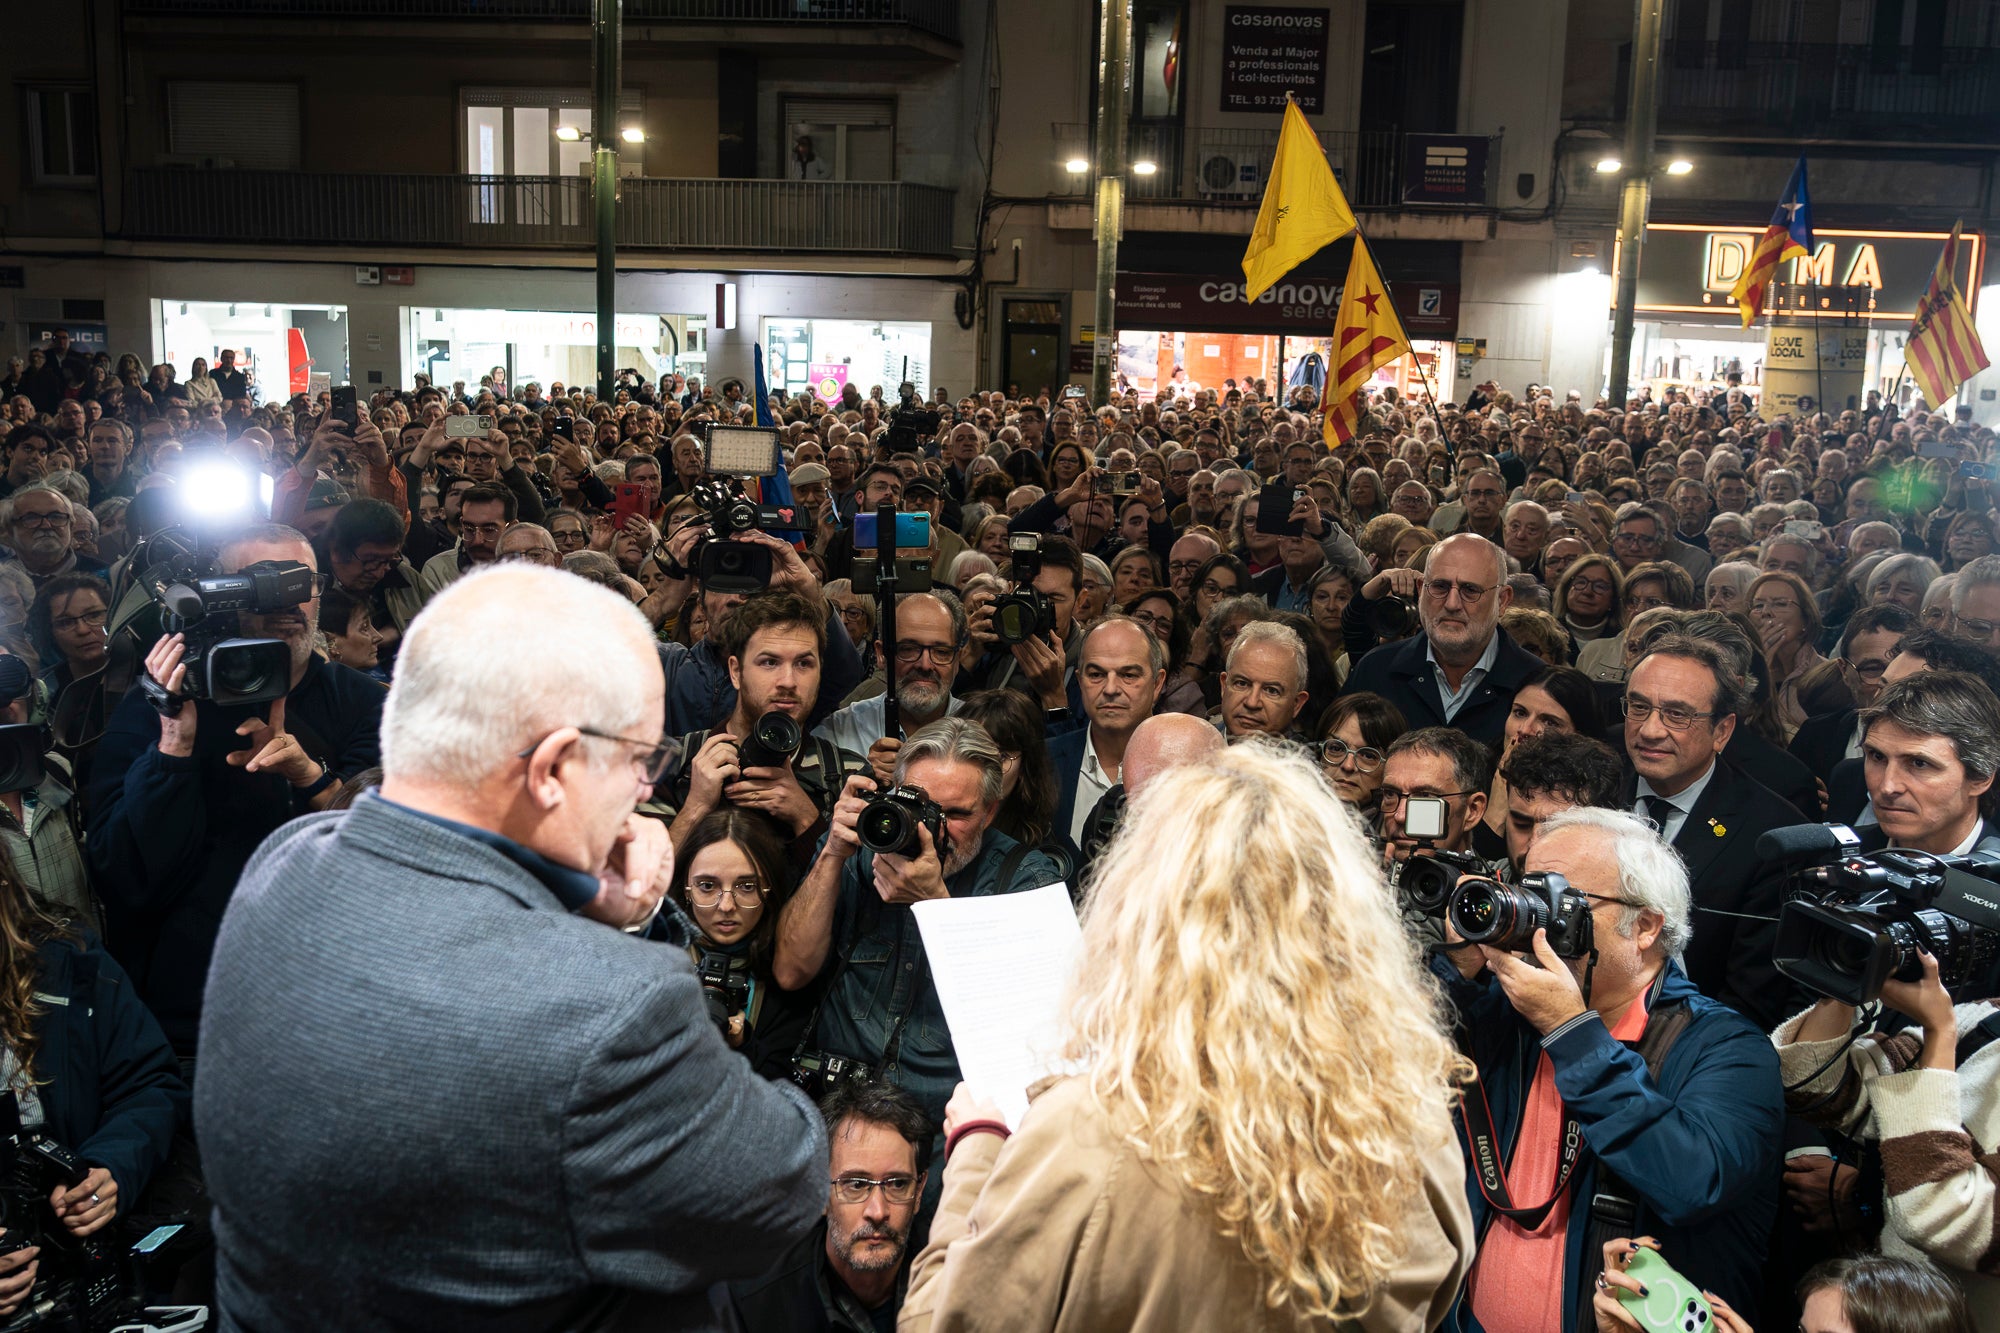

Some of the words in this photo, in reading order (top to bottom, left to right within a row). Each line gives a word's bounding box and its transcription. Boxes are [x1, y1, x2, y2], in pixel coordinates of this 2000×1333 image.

[1231, 14, 1323, 28] casanovas
[1232, 45, 1269, 56] Venda
[1271, 47, 1282, 57] al
[1285, 47, 1319, 59] Major
[1228, 60, 1236, 69] a
[1239, 60, 1320, 71] professionals
[1229, 94, 1252, 104] TEL.
[1254, 96, 1266, 105] 93
[1303, 97, 1316, 106] 32
[1703, 233, 1883, 291] DMA
[1282, 305, 1339, 319] selec
[582, 321, 643, 337] Oica
[41, 331, 104, 343] PICE
[1773, 336, 1803, 347] LOVE
[1770, 347, 1805, 358] LOCAL
[897, 790, 915, 800] Nikon
[1843, 866, 1861, 876] SONY
[1522, 878, 1543, 887] Canon
[1477, 1135, 1499, 1191] Canon
